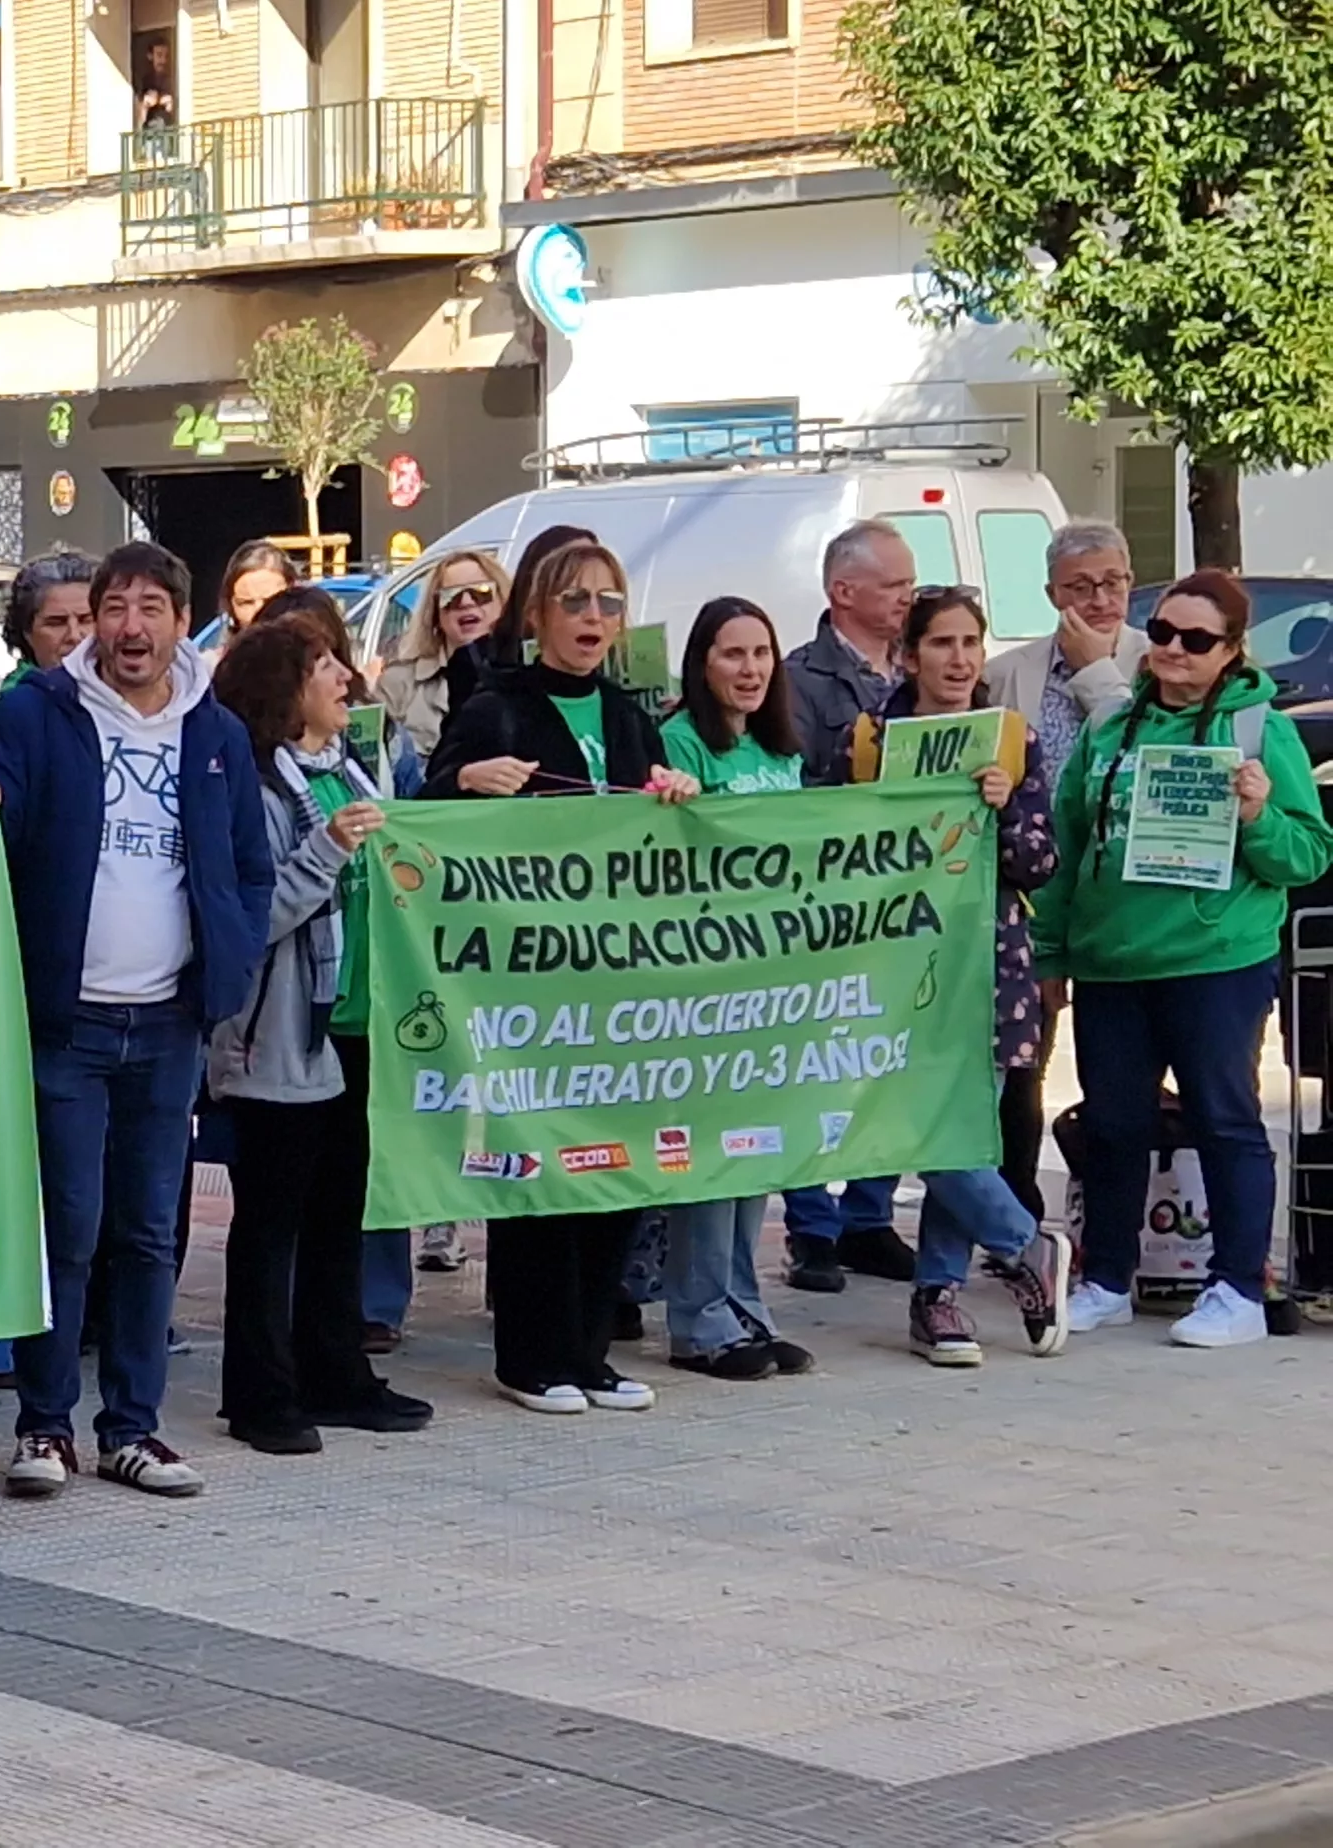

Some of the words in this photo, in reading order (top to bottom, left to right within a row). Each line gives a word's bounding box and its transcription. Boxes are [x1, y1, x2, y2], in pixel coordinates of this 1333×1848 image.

[913, 725, 971, 778] NO!
[441, 852, 595, 902] DINERO
[607, 833, 802, 897] PÚBLICO,
[818, 825, 933, 882] PARA
[433, 926, 492, 974] LA
[507, 901, 766, 973] EDUCACIÓN
[771, 890, 943, 958] PÚBLICA
[467, 1005, 536, 1064] ¡NO
[543, 1004, 596, 1047] AL
[605, 983, 811, 1043] CONCIERTO
[816, 974, 883, 1020] DEL
[413, 1057, 694, 1115] BACHILLERATO
[701, 1052, 730, 1096] Y
[729, 1044, 787, 1090] 0-3
